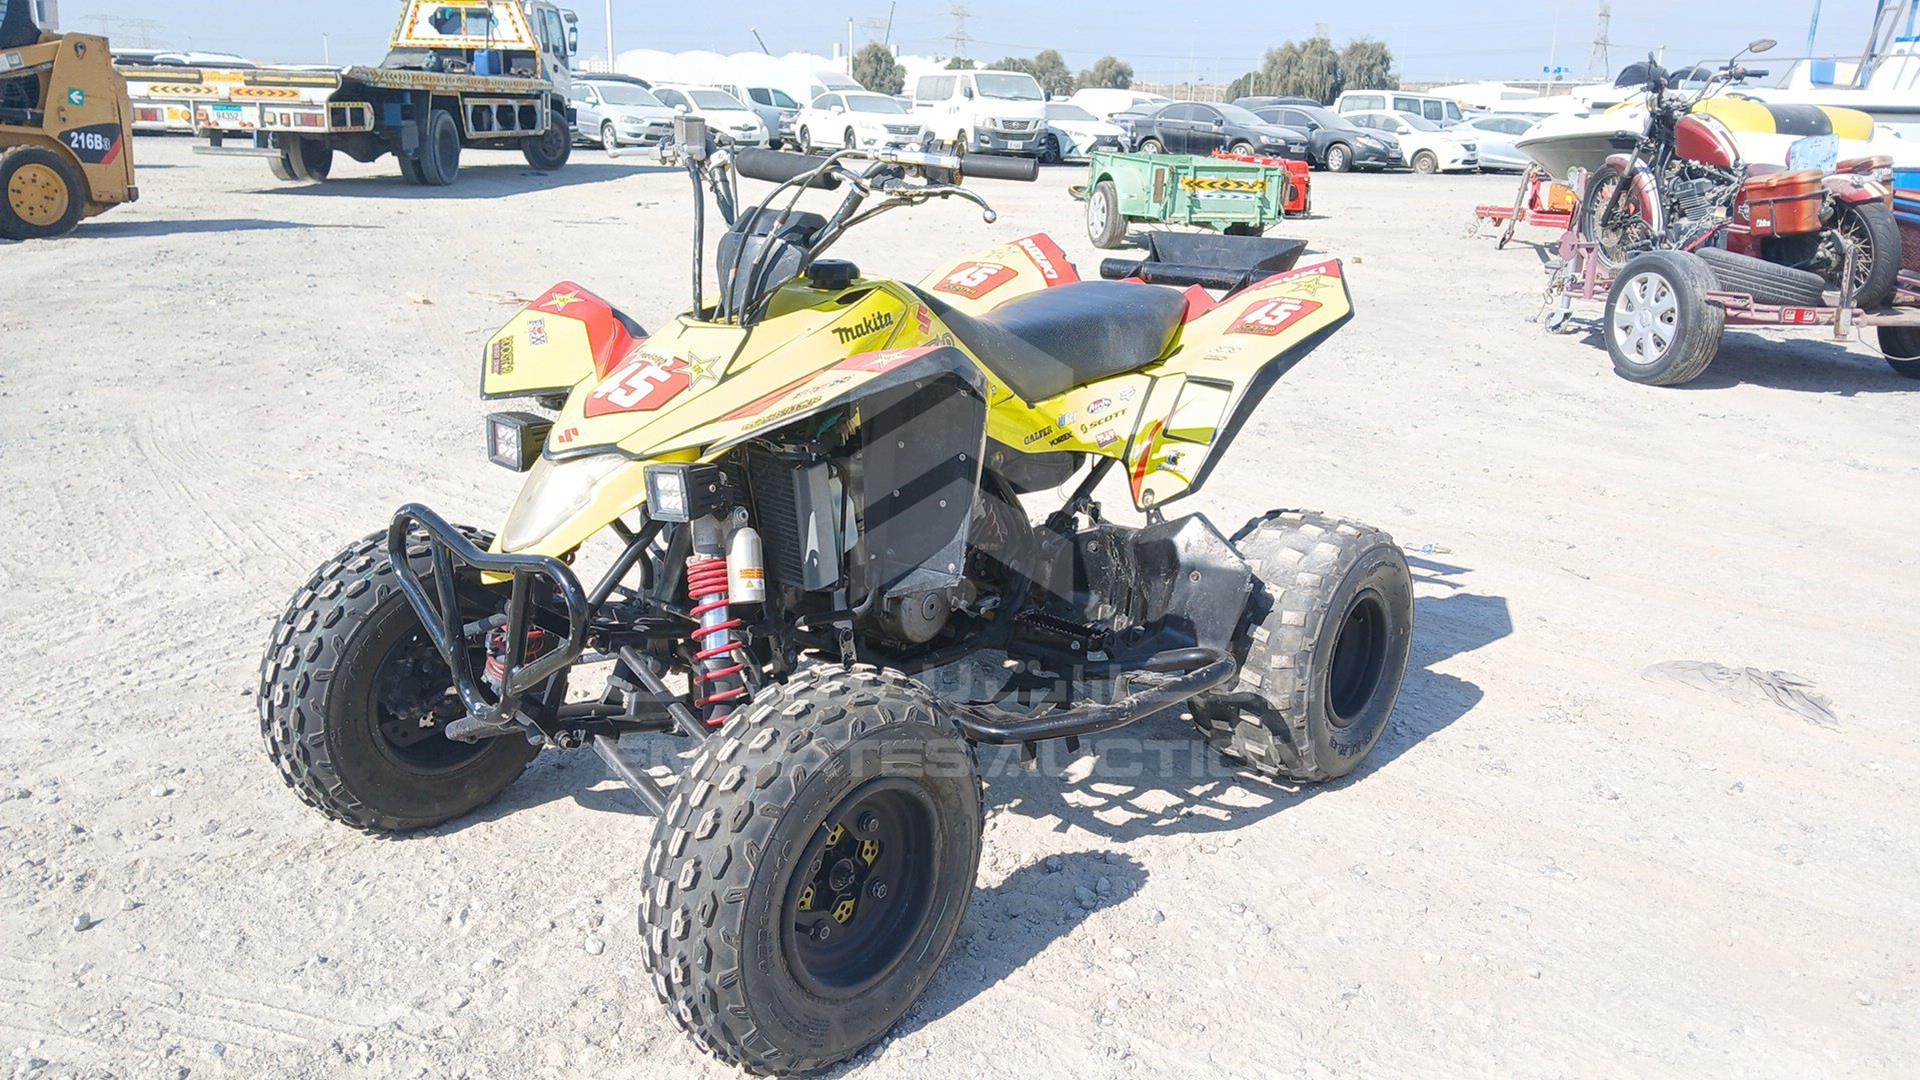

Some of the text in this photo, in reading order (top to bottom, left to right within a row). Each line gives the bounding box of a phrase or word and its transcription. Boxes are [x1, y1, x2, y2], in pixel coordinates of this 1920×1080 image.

[831, 311, 895, 345] Makita
[1089, 407, 1127, 429] SCOTT
[1023, 425, 1053, 446] GALFER
